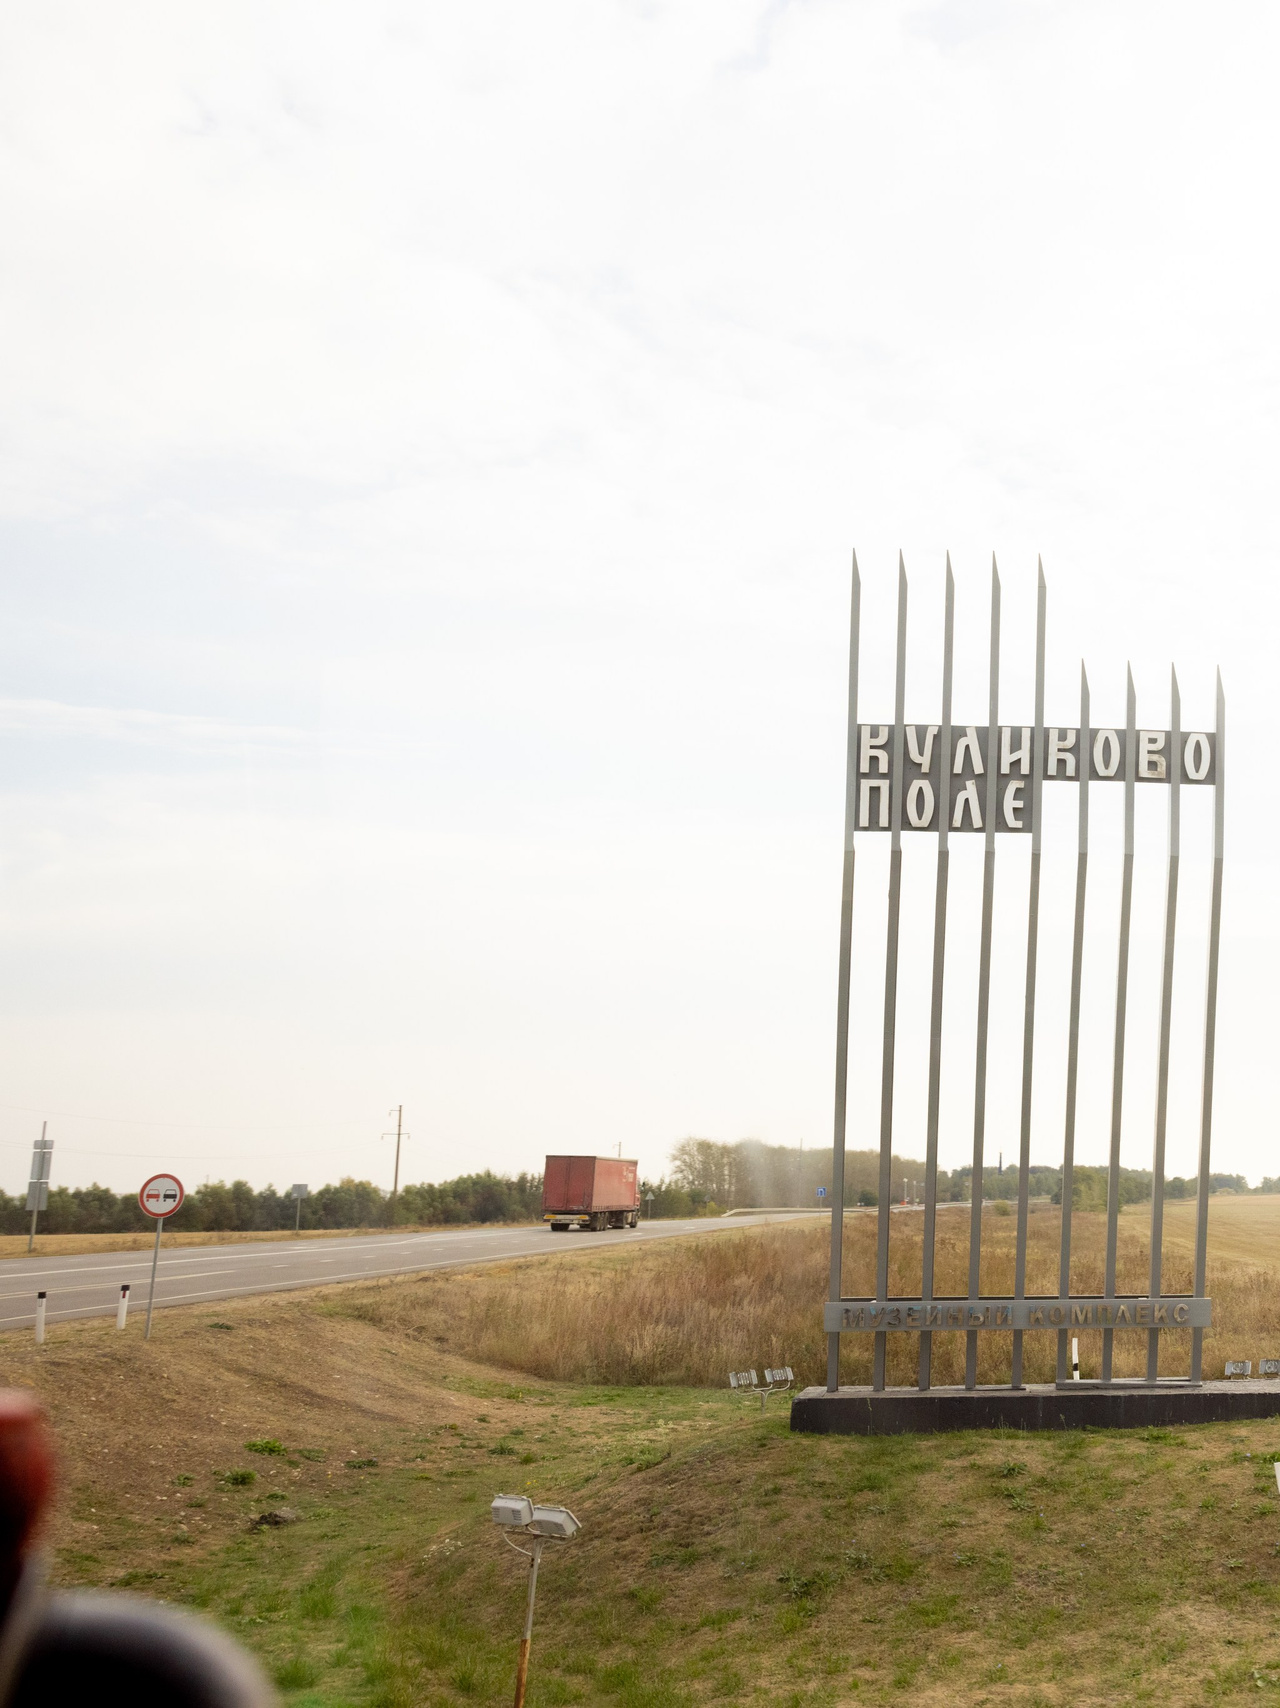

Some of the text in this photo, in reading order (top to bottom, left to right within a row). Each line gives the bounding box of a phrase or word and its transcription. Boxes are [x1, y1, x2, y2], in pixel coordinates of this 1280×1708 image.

[859, 725, 1211, 780] КУЛИКОВО
[858, 779, 1025, 829] ПОЛЕ
[1028, 1303, 1190, 1326] КОМПЛЕКС
